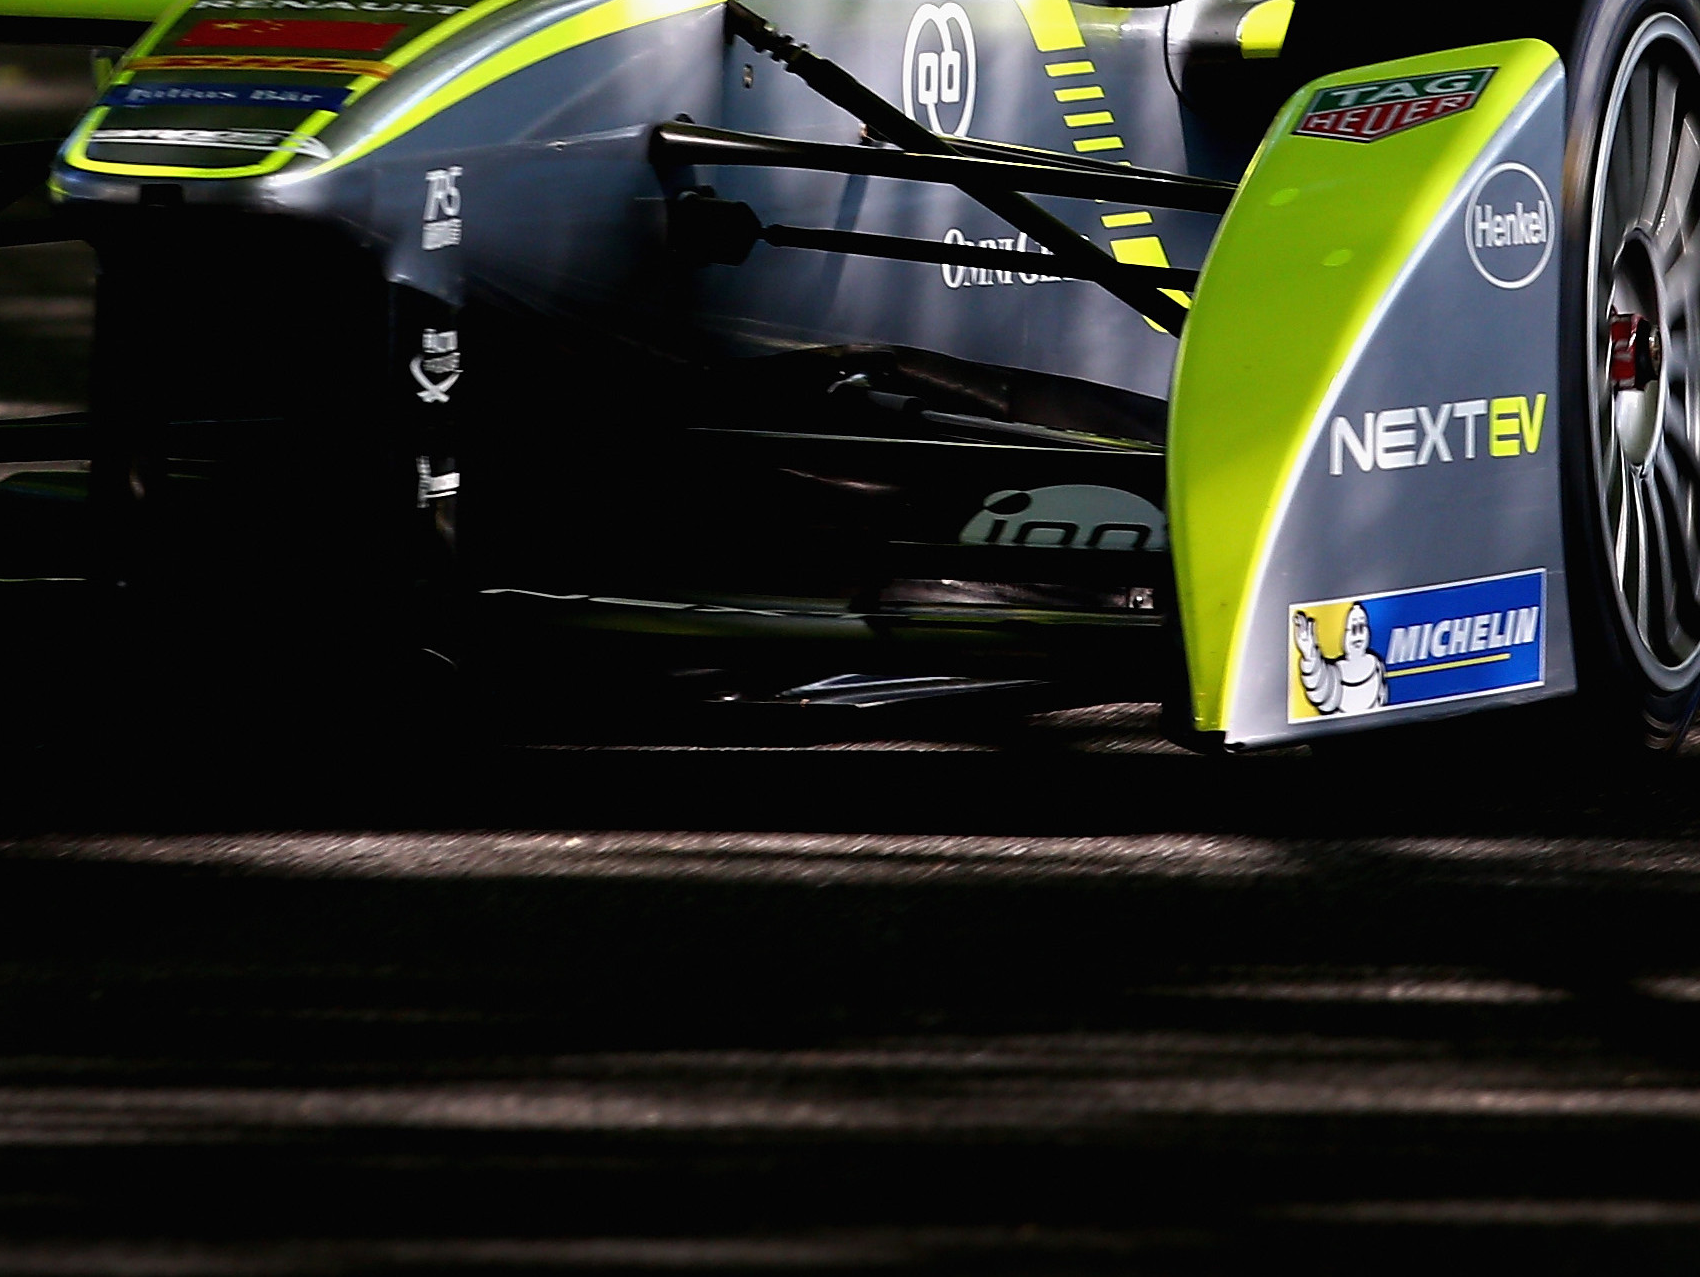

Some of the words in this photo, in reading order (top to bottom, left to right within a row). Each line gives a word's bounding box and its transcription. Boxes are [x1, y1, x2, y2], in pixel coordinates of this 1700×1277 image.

[193, 0, 471, 14] RENAULT
[1331, 73, 1474, 106] TAG
[1306, 95, 1466, 135] HEUER
[1474, 200, 1547, 248] Henkel
[1329, 392, 1547, 476] NEXTEV
[1386, 606, 1540, 665] MICHELIN
